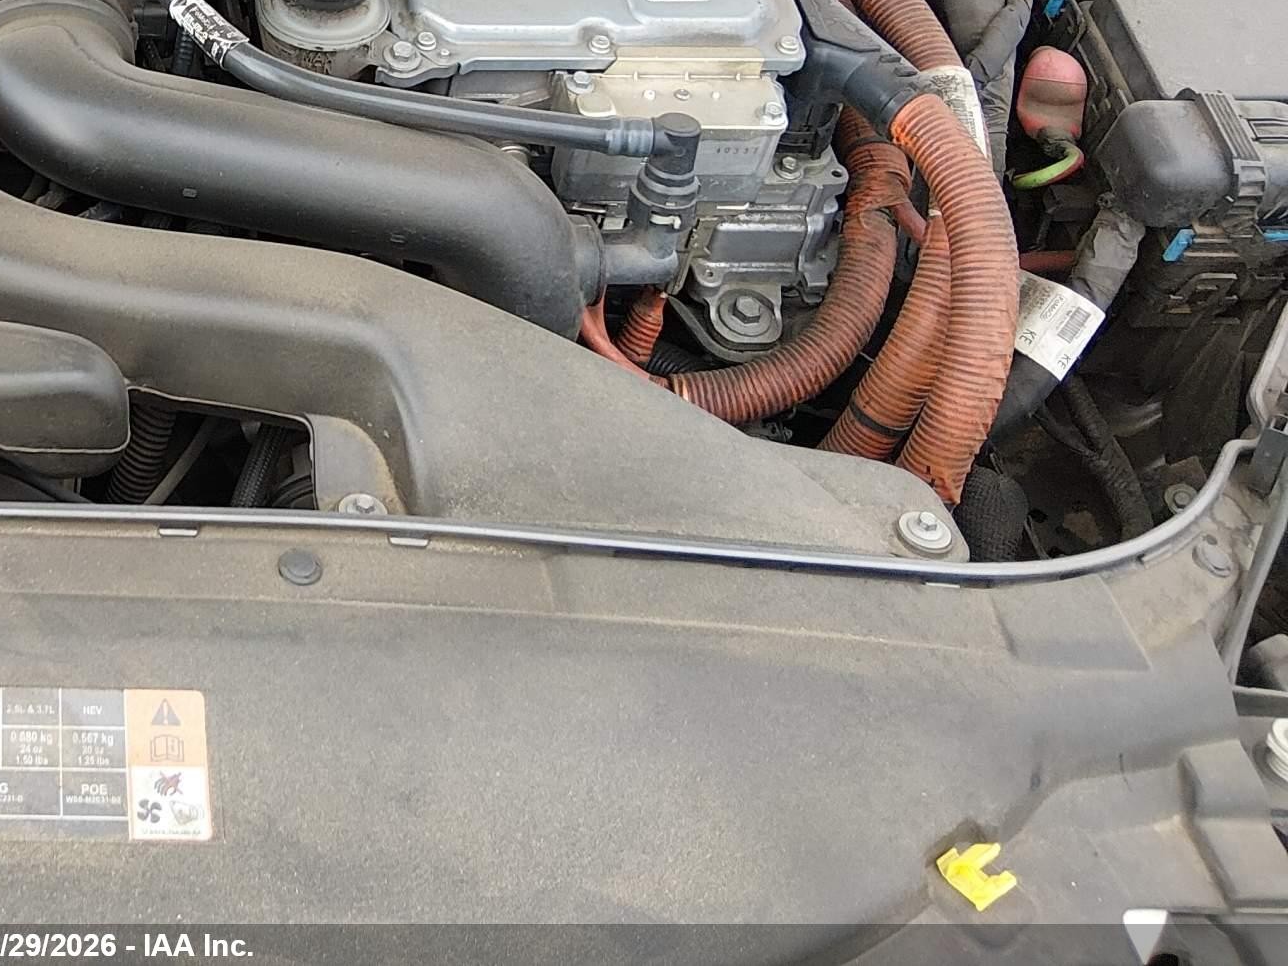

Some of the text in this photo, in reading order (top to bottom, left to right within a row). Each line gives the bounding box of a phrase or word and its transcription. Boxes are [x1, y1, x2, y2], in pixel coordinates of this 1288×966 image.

[40, 731, 53, 746] kg
[101, 732, 114, 747] kg
[81, 783, 108, 795] POE
